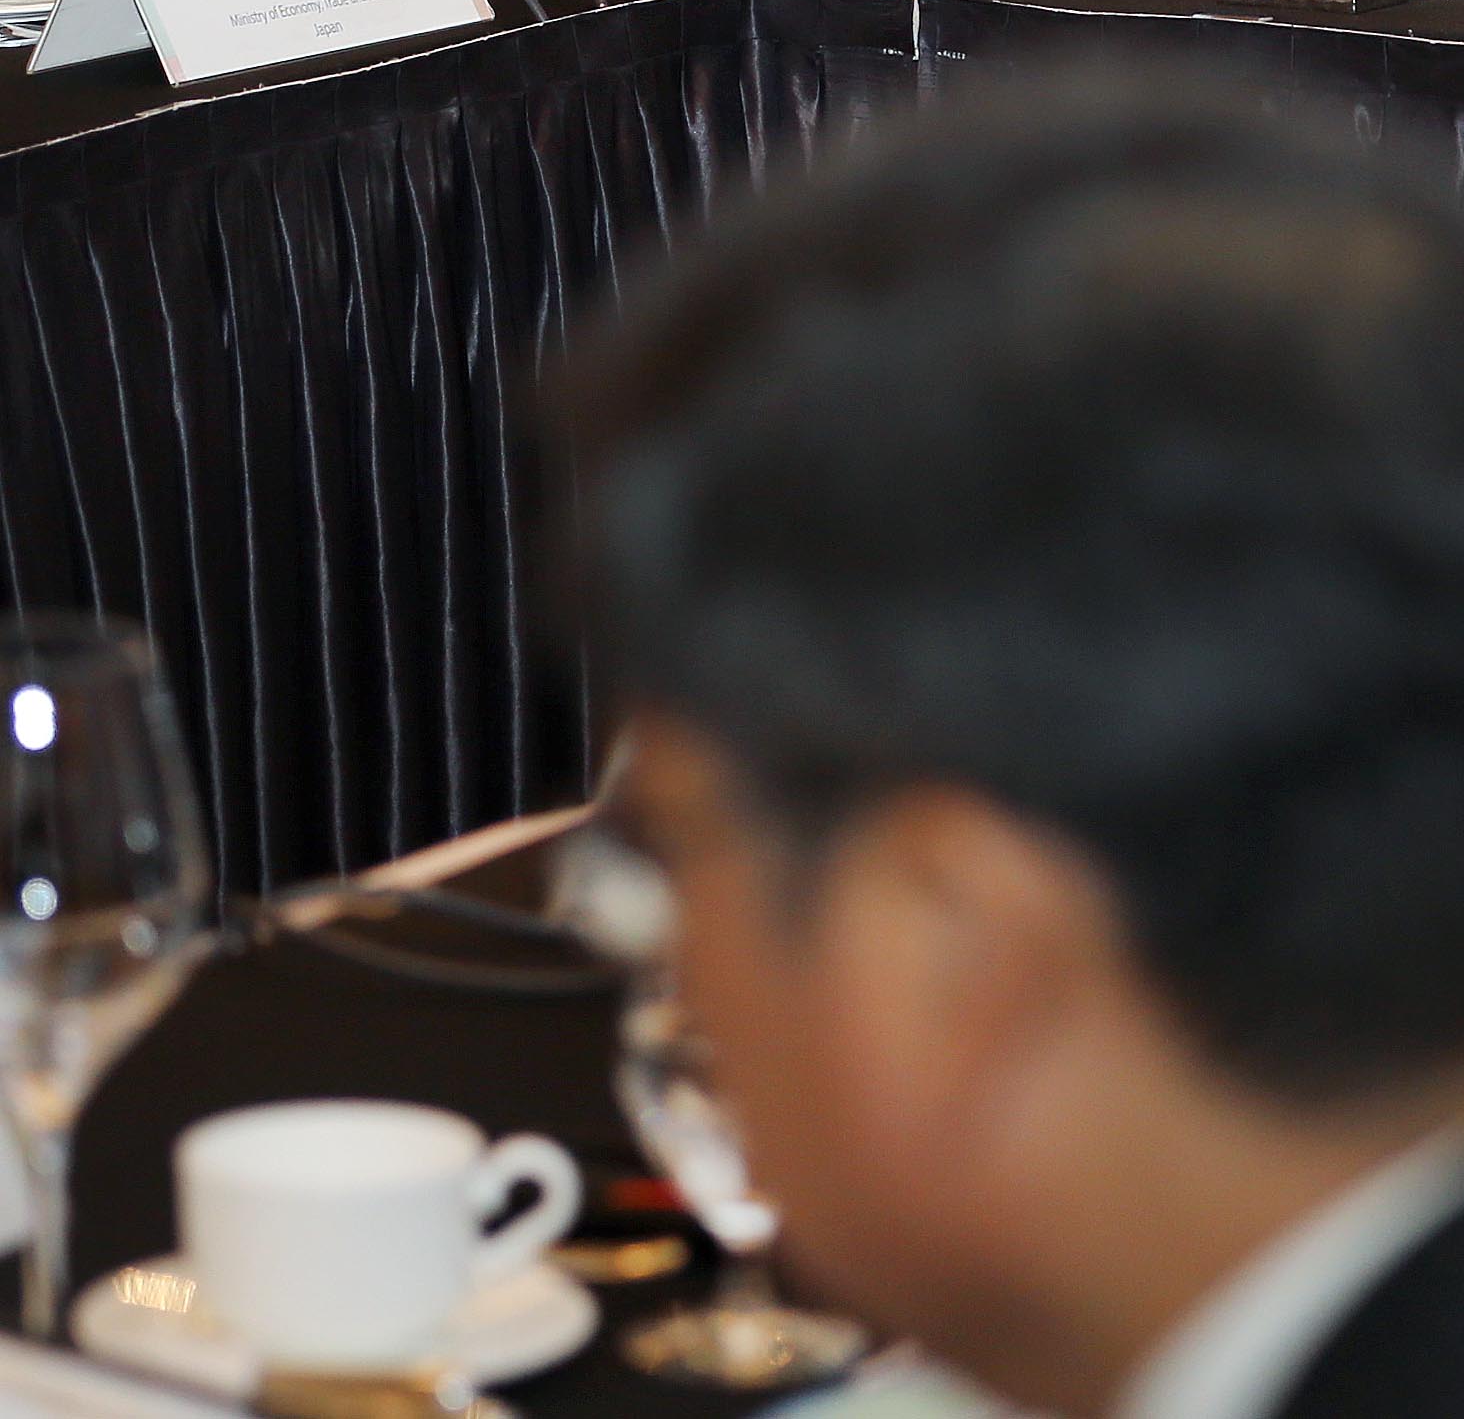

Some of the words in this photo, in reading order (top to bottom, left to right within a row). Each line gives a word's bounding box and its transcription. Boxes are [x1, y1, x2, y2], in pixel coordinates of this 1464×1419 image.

[229, 6, 268, 27] Ministry
[269, 5, 280, 20] of
[280, 0, 324, 19] Economy,
[314, 21, 343, 38] Japan
